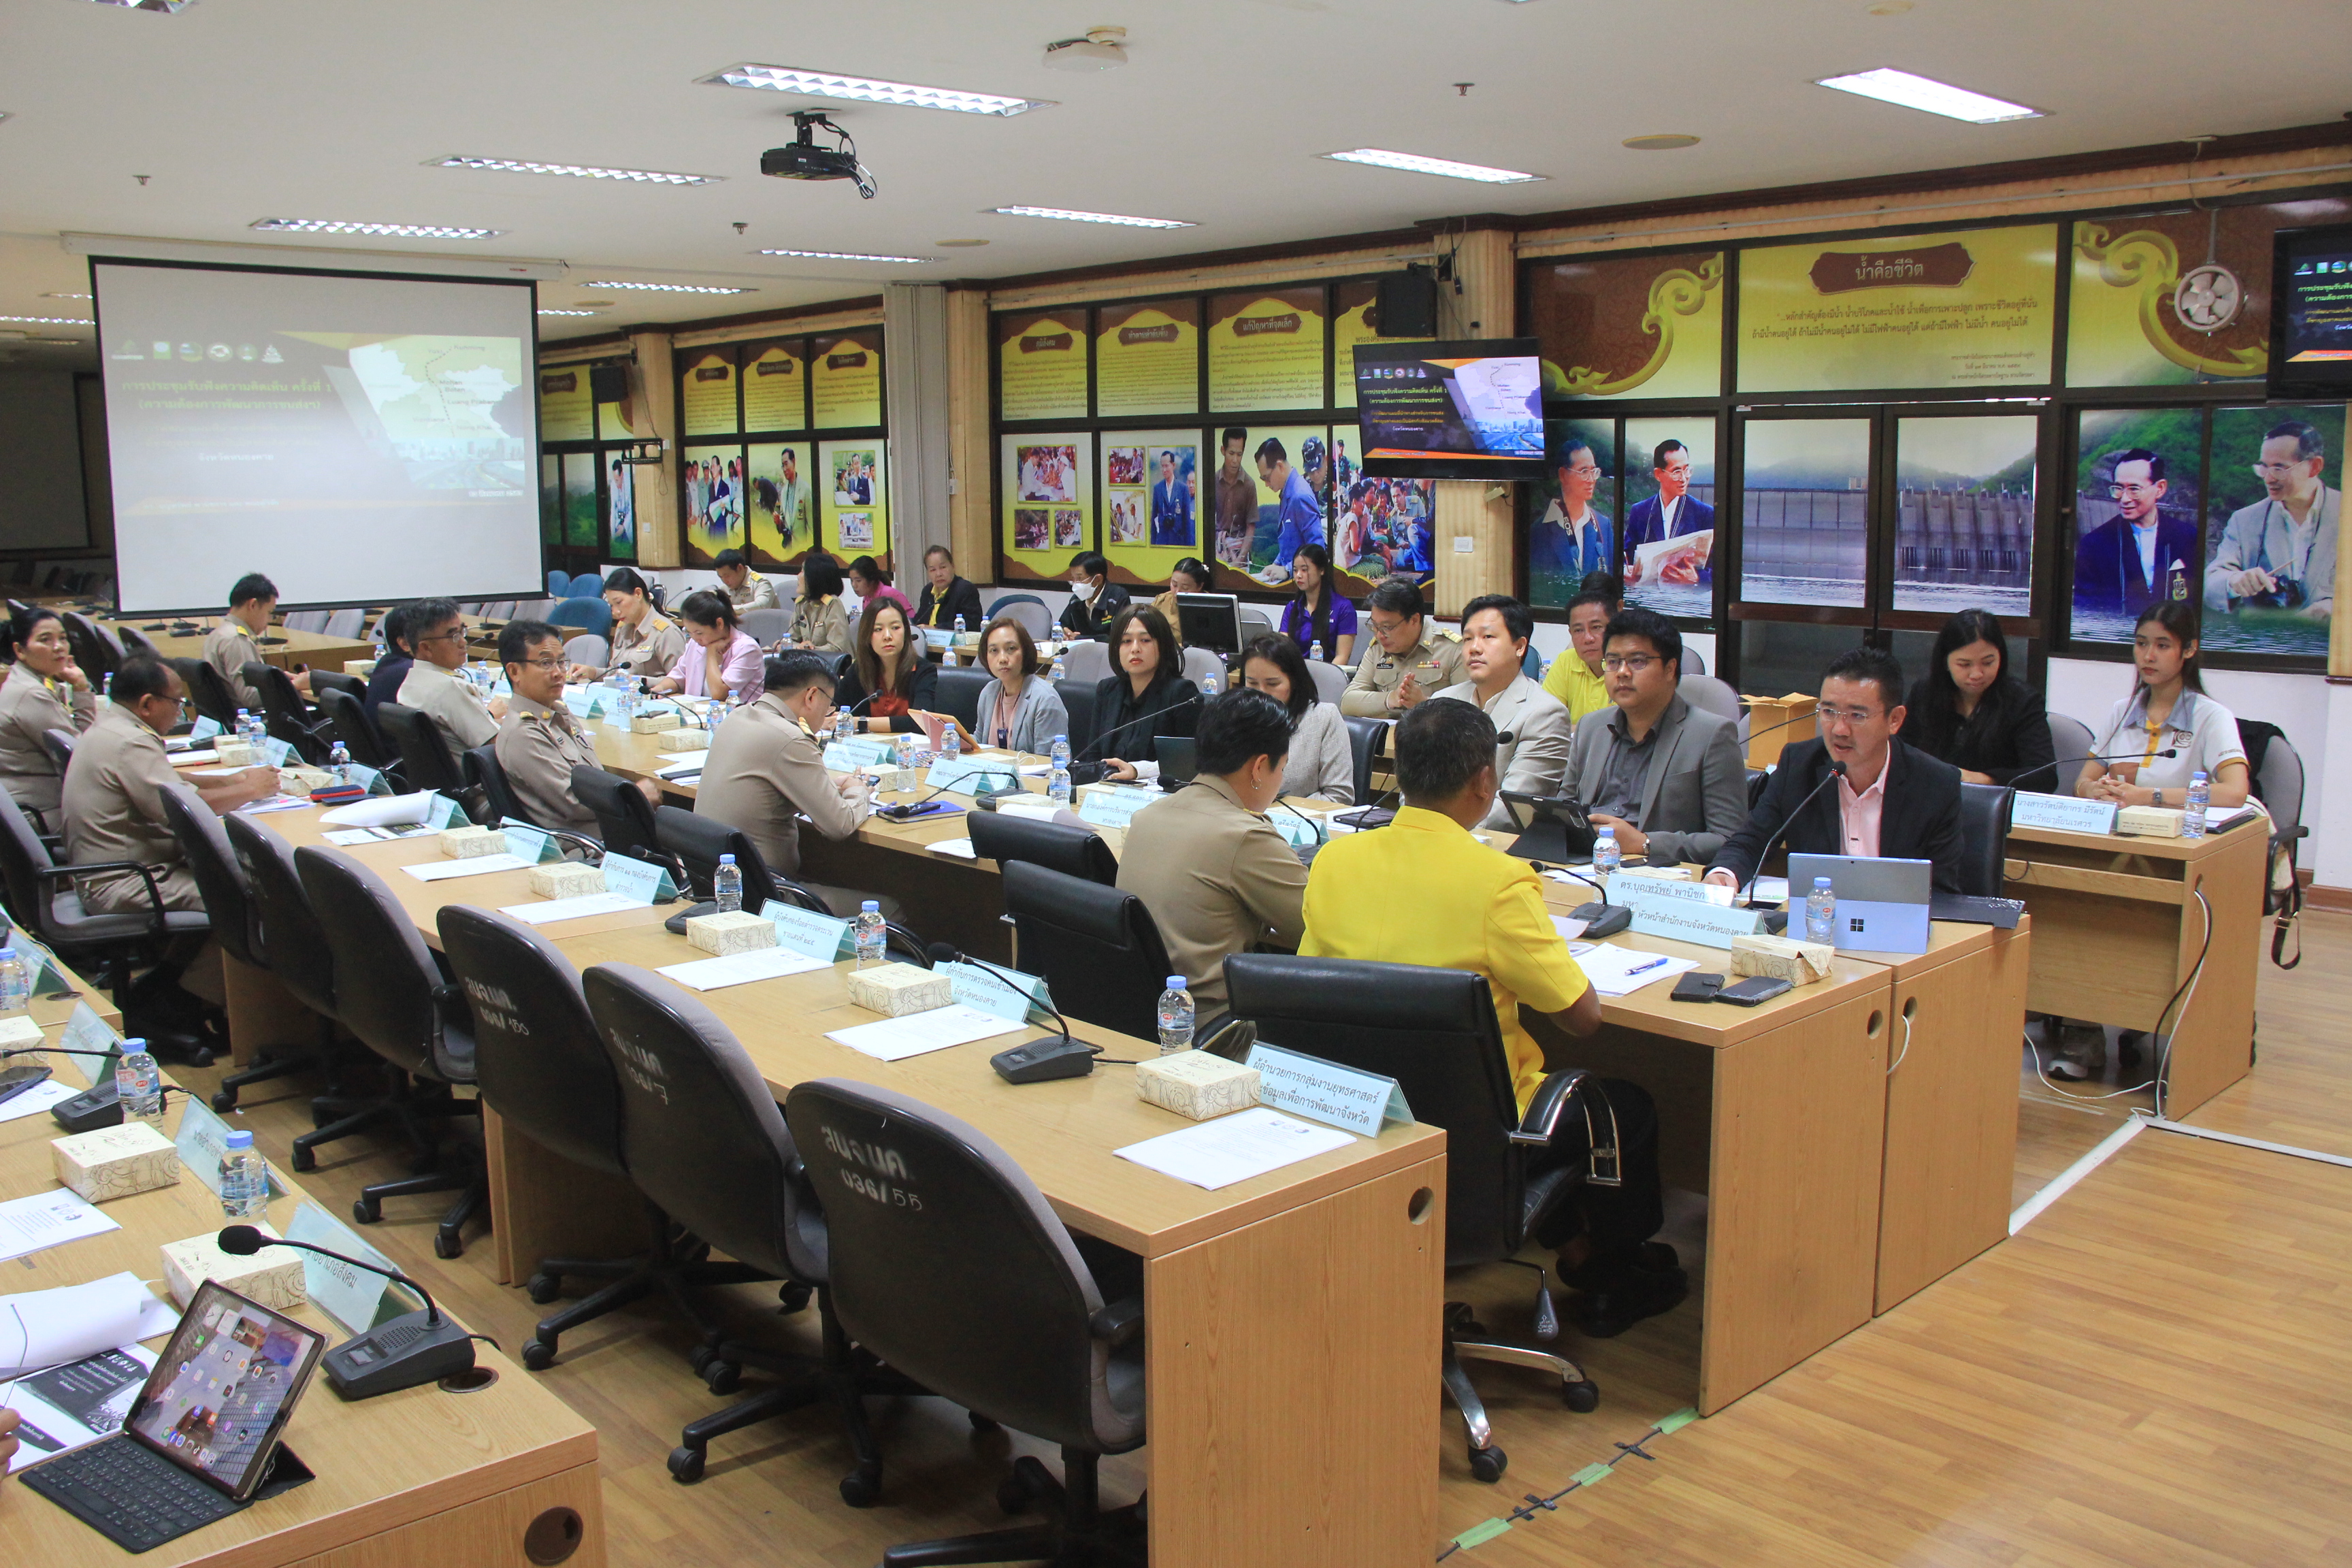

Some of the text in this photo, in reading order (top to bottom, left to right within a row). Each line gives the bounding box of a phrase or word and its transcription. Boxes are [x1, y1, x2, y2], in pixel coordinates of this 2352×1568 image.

[1855, 255, 1924, 280] น้ำคือชีวิต
[1128, 326, 1169, 340] ทำตามลำดับขั้น
[1242, 316, 1293, 333] แก้ปัญหาที่จุดเล็ก
[1035, 339, 1056, 349] ภูมิสังคม
[292, 377, 321, 392] ครั้งที่
[326, 383, 331, 391] 1
[2021, 813, 2092, 828] มหาวิทยาลัยนเรศวร
[604, 860, 625, 875] ผู้กำกับการ
[632, 870, 657, 883] กองบังคับการ
[615, 881, 634, 894] ตำรวจน้ำ
[774, 911, 834, 936] ผู้บังคับกองร้อยตำรวจตระเวน
[1637, 909, 1749, 937] หัวหน้าสำนักงานจังหวัดหนองคาย
[945, 965, 1017, 995] ผู้กำกับการตรวจคนเข้าเมอง
[953, 985, 997, 1007] จังหวัดหนองคาย
[1253, 1058, 1381, 1104] ผ้อำนวยการกลุ่มงานยุทธศาสตร์
